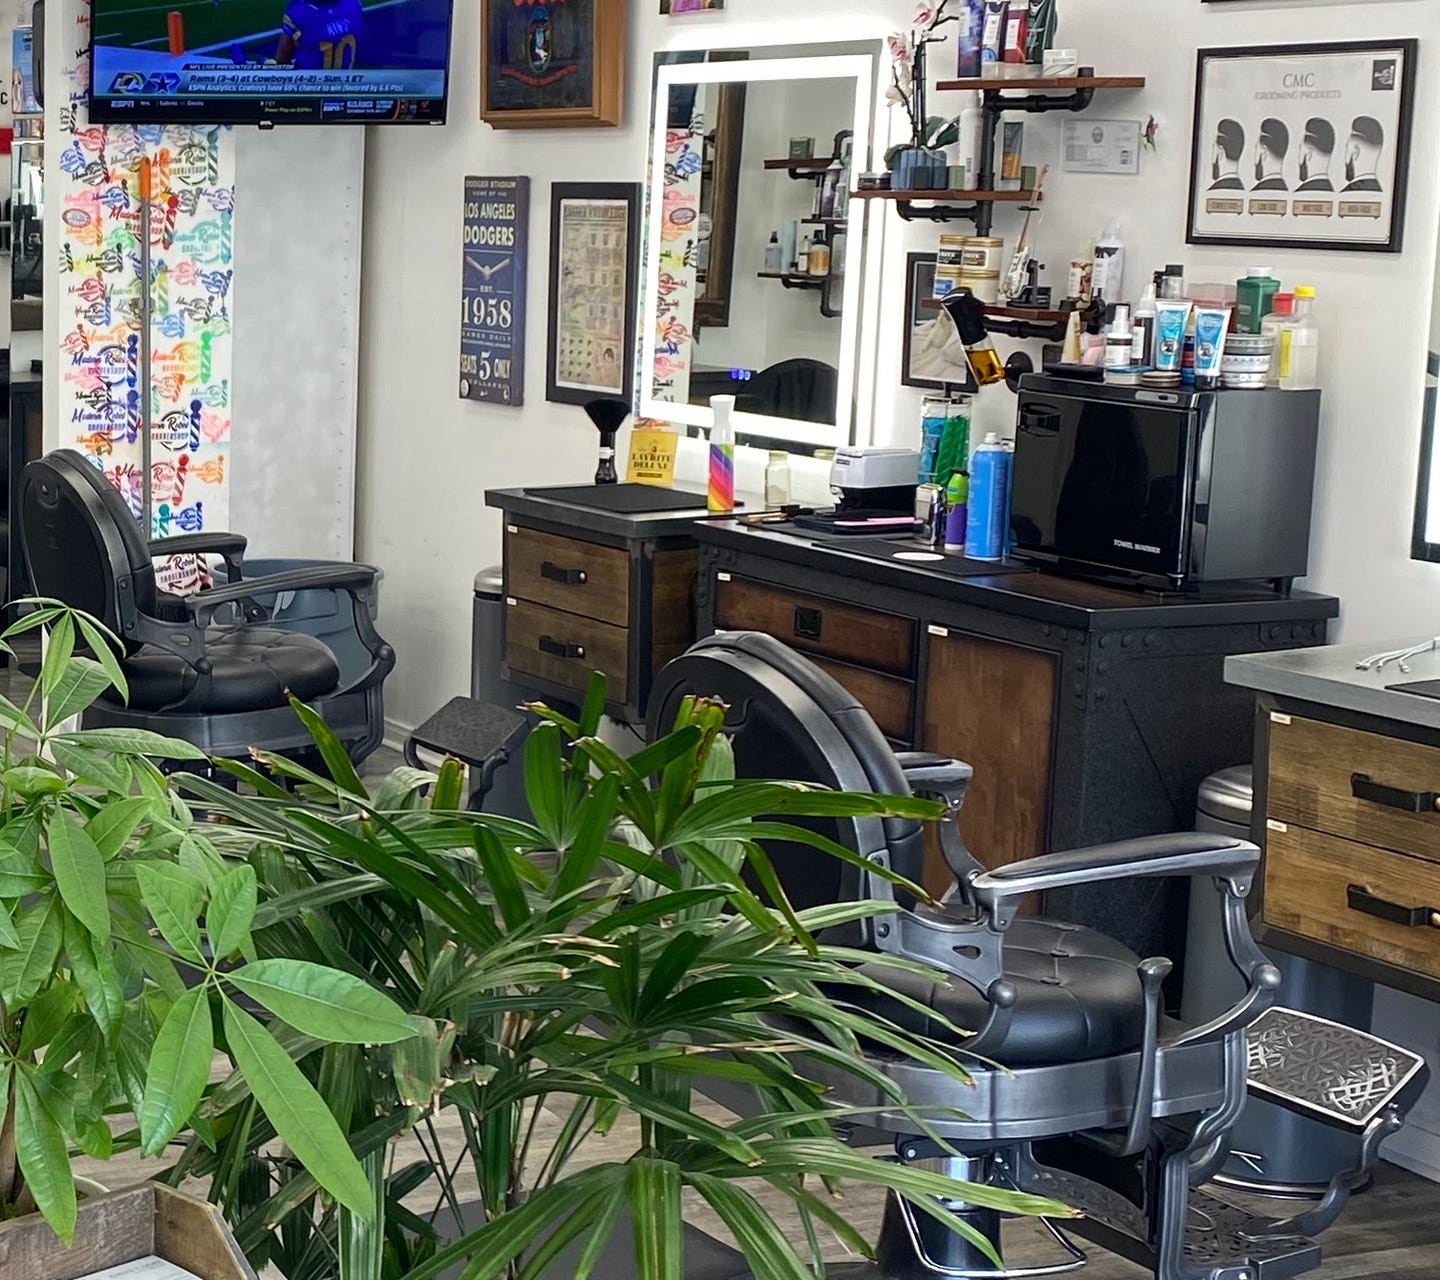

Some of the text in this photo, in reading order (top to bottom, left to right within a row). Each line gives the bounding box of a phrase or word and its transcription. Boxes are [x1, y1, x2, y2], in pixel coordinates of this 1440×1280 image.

[190, 75, 215, 83] Rams
[240, 75, 250, 83] at
[252, 75, 293, 84] Cowboys
[1283, 73, 1315, 88] CMC
[1300, 90, 1341, 99] PRODUCTS
[480, 203, 515, 220] ANGELES
[464, 225, 514, 246] DODGERS
[463, 296, 511, 328] 1958
[480, 350, 491, 380] 5
